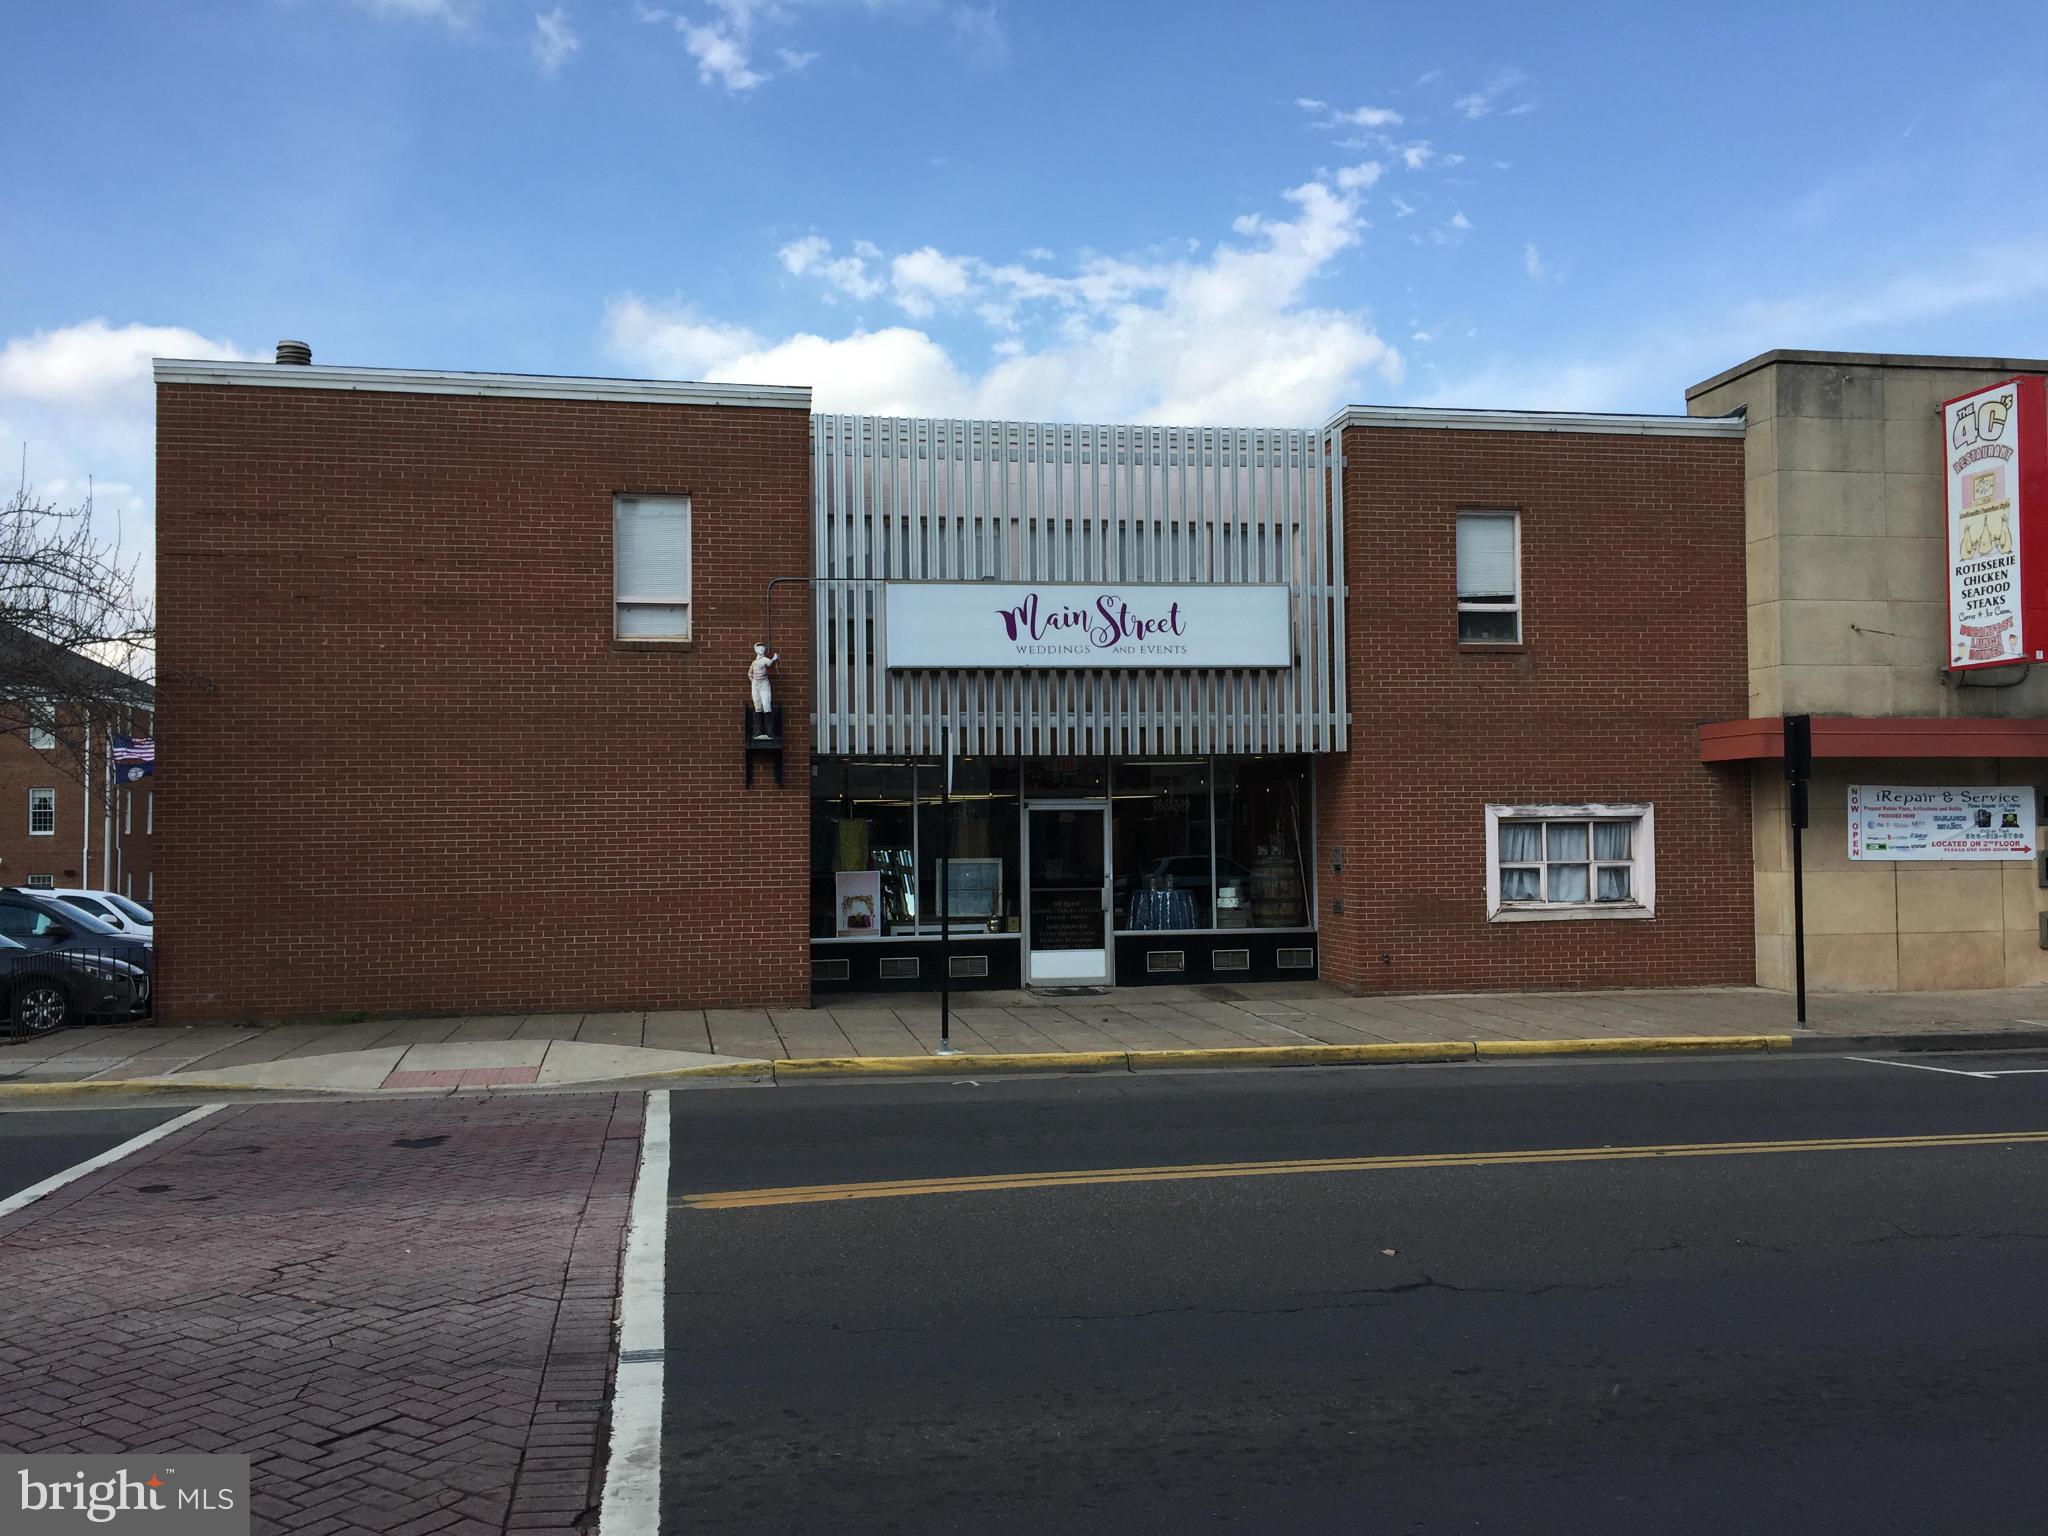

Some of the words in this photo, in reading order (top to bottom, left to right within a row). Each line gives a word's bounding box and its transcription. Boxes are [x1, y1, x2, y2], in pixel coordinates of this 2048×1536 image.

[1957, 402, 1975, 419] THE
[1953, 444, 2013, 474] RESTAURANT
[1955, 555, 2016, 576] ROTISSERIE
[1963, 569, 2008, 587] CHICKEN
[1961, 581, 2010, 599] SEAFOOD
[1966, 595, 2006, 610] STEAKS
[994, 593, 1093, 641] Main
[1090, 594, 1186, 649] Street
[1959, 615, 2014, 637] BREAKFAST
[1016, 644, 1091, 655] WEDDINGS
[1112, 646, 1135, 654] AND
[1140, 644, 1188, 655] EVENTS
[1970, 633, 2003, 649] LUNCH
[1851, 788, 1859, 812] NOW
[1876, 789, 1936, 806] iRepair
[1942, 790, 1954, 803] &
[1961, 790, 2019, 803] Service
